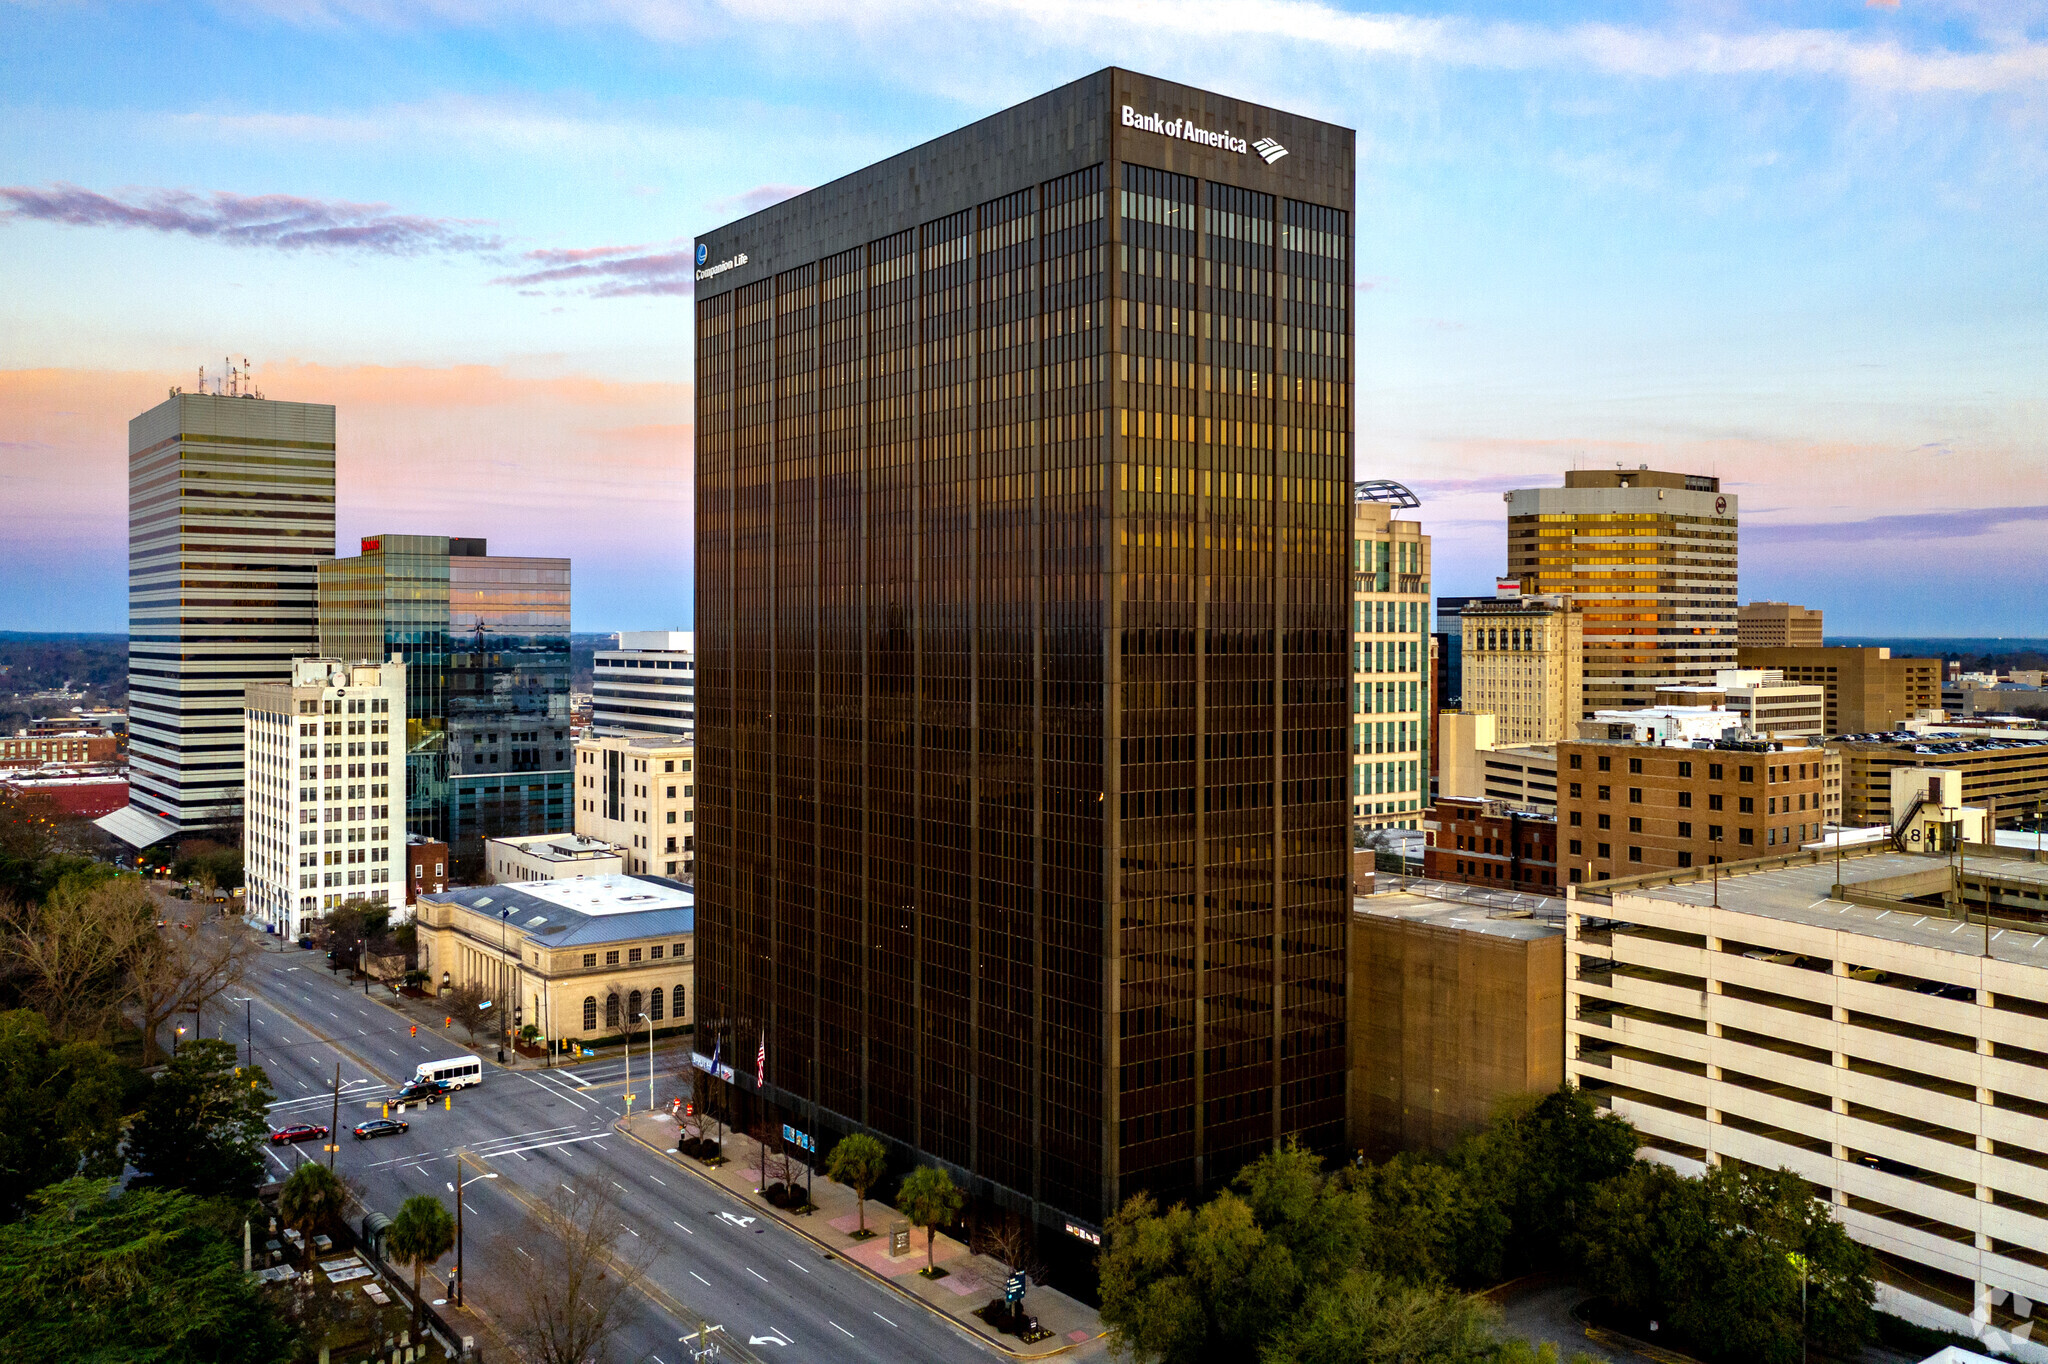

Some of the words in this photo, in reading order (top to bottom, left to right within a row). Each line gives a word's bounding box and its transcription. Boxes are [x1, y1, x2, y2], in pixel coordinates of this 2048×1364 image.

[1121, 105, 1165, 135] Bank
[1165, 118, 1182, 138] of
[1182, 120, 1247, 154] America
[696, 260, 733, 281] Companion
[734, 253, 748, 267] Life
[1911, 829, 1921, 842] 8
